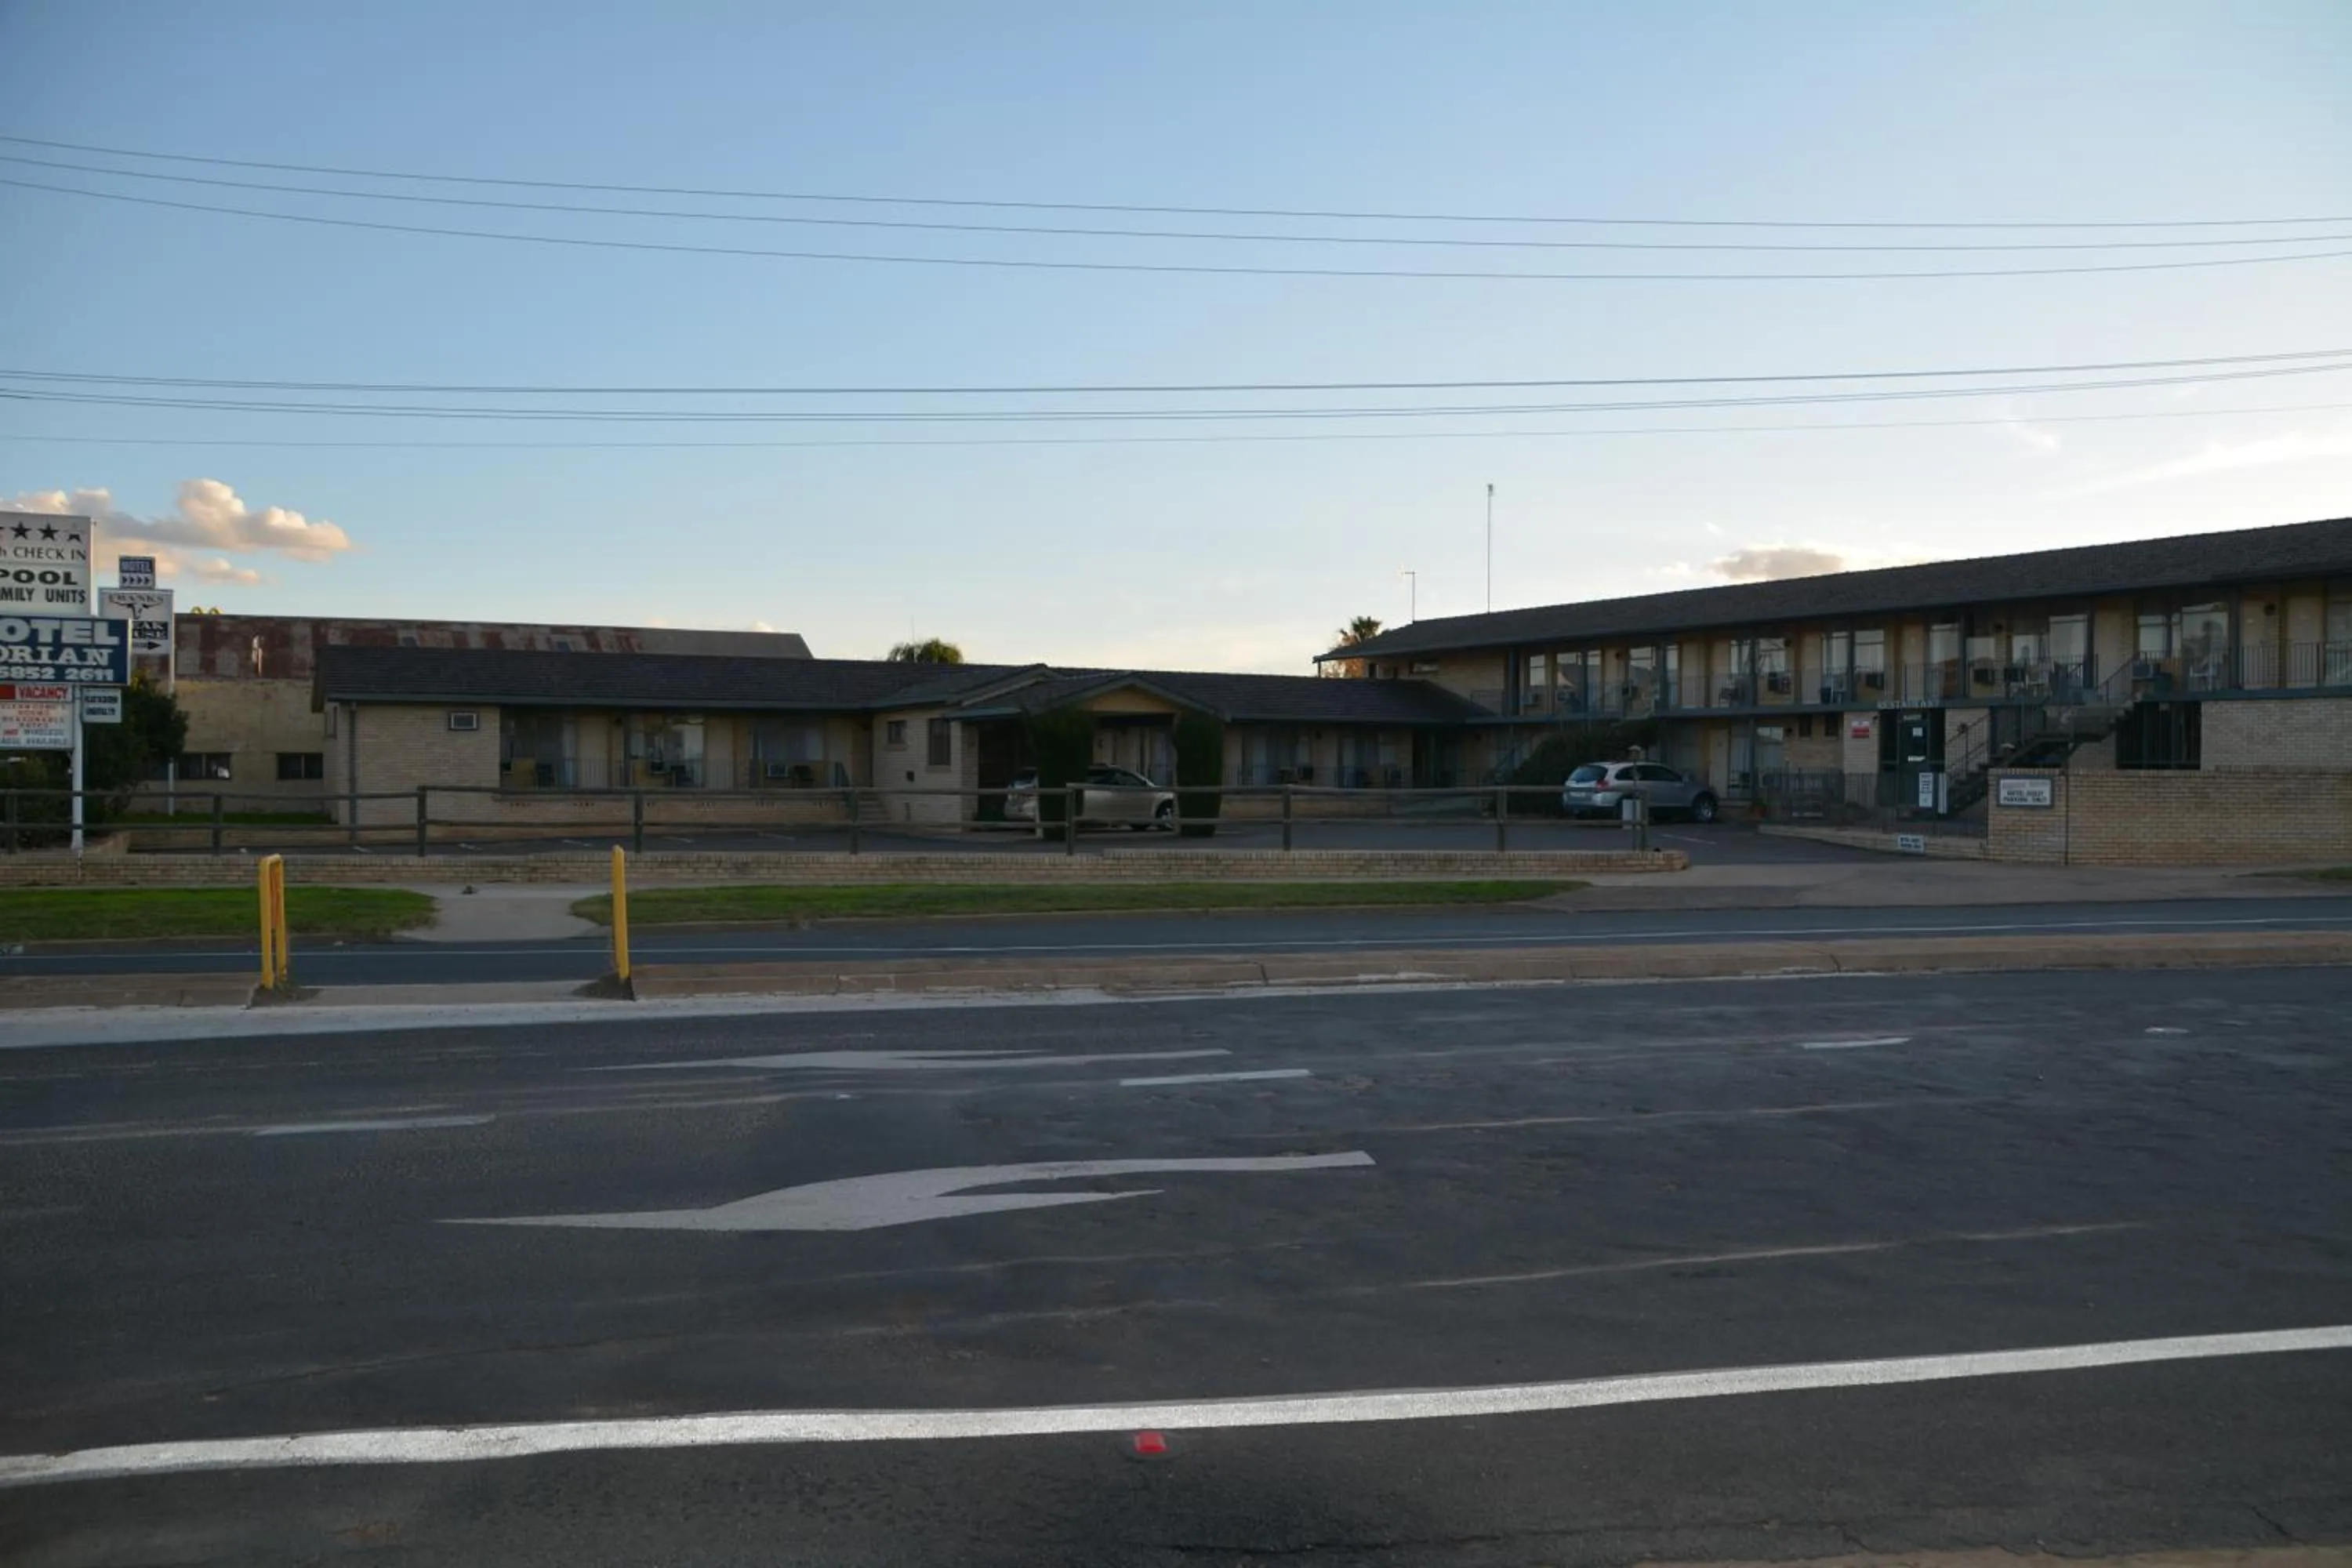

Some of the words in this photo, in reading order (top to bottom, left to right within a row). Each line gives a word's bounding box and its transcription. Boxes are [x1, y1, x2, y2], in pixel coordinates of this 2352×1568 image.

[13, 546, 64, 560] CHECK
[71, 549, 86, 561] IN
[45, 589, 86, 604] UNITS
[0, 618, 120, 644] OTEL
[64, 669, 114, 681] 2611
[19, 686, 68, 699] VACANCY
